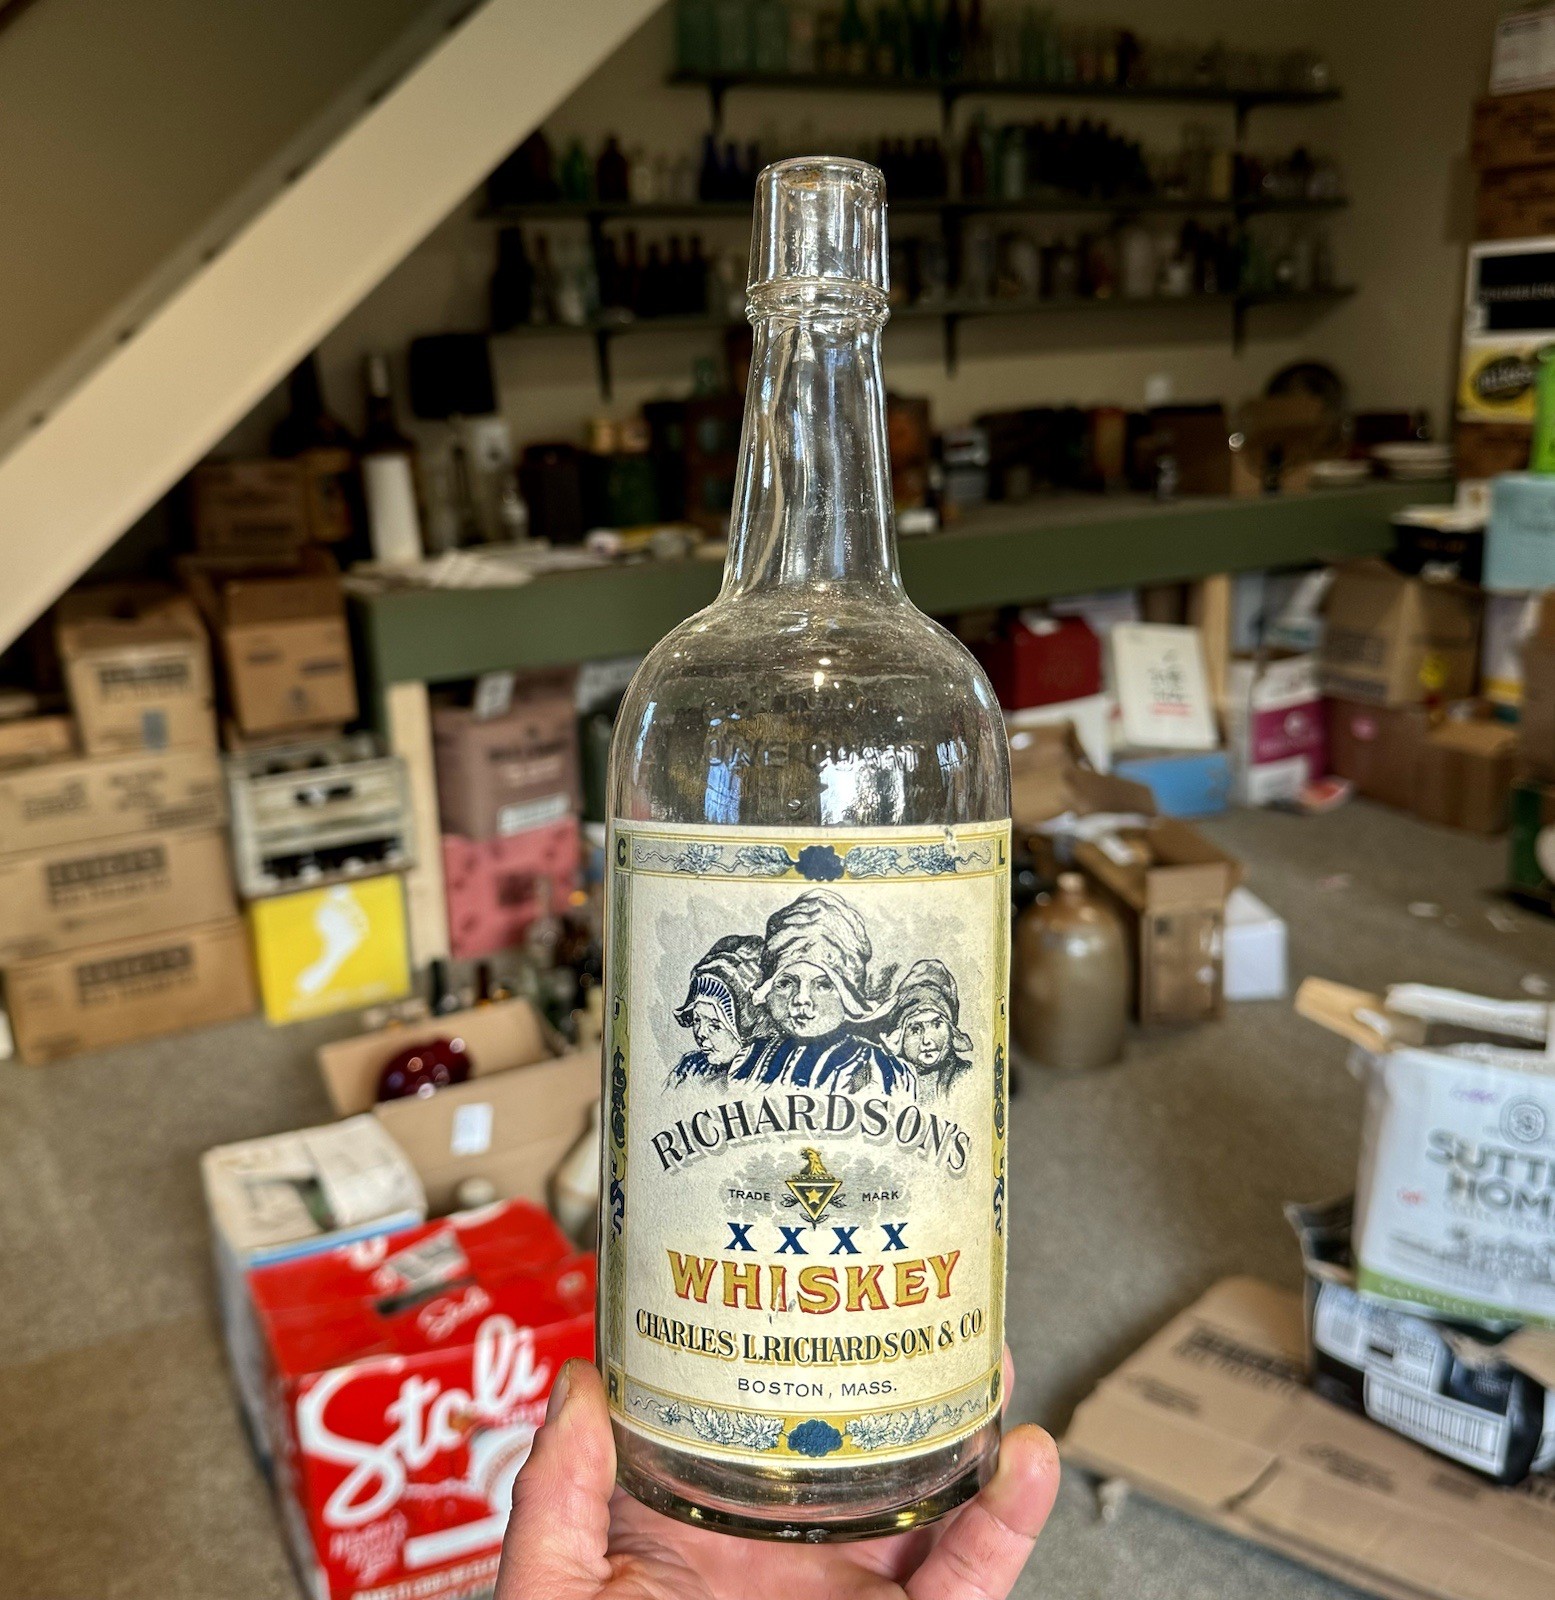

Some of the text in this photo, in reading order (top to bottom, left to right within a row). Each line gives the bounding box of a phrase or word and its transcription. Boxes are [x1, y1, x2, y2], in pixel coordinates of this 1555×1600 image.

[650, 1093, 971, 1173] RICHARDSON'S
[1425, 1127, 1555, 1190] SUTT
[728, 1188, 900, 1202] TRADE MARK
[1445, 1168, 1555, 1219] HOM
[666, 1250, 962, 1316] WHISKEY
[636, 1308, 735, 1359] CHARLES
[937, 1320, 955, 1349] &
[841, 1378, 897, 1398] MASS.
[296, 1314, 552, 1529] Stoli
